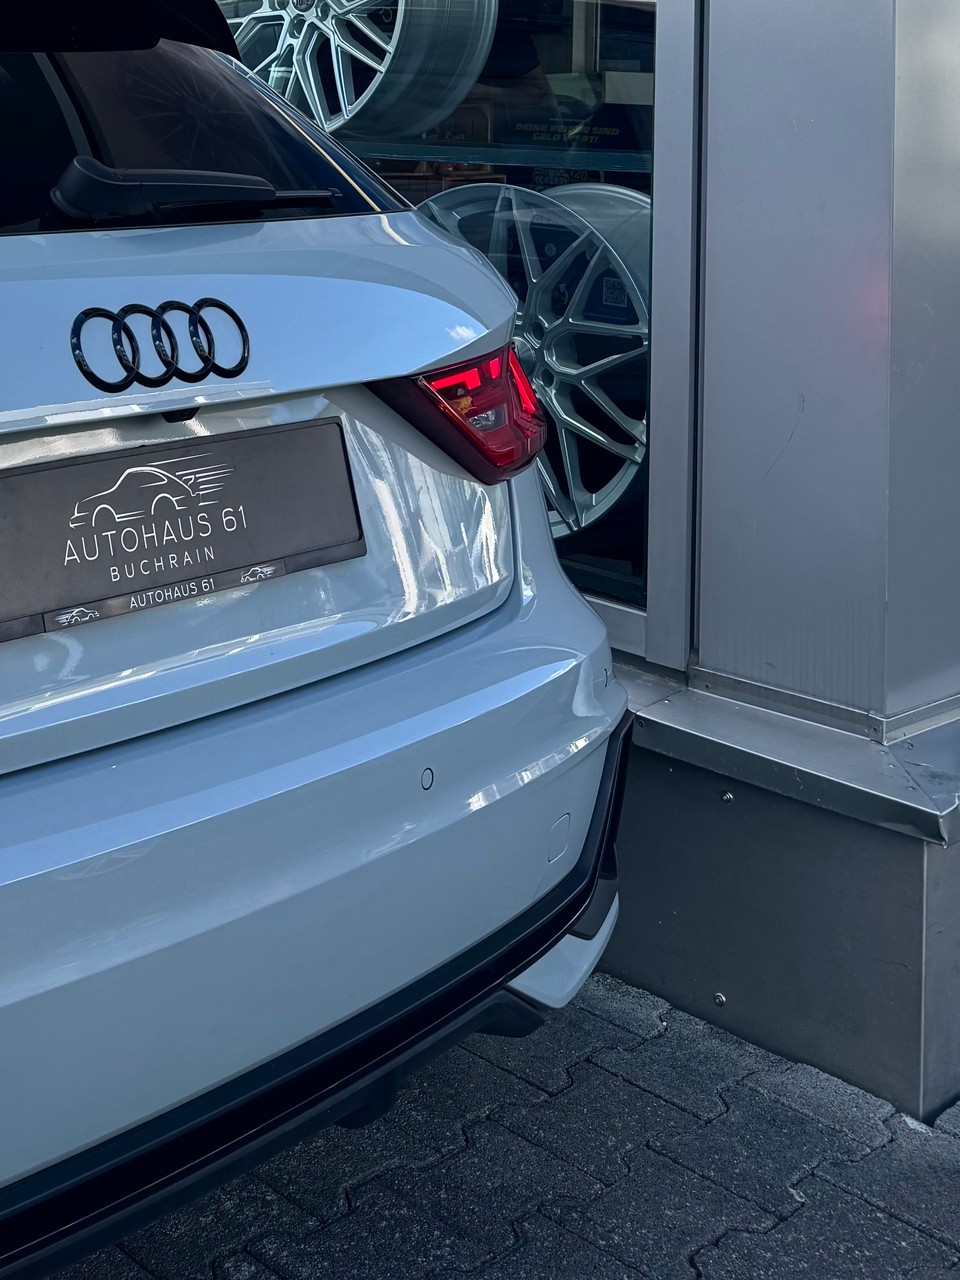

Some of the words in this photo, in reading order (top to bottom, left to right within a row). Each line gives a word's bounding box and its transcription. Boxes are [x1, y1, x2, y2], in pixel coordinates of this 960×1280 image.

[63, 513, 212, 566] AUTOHAUS
[222, 505, 247, 532] 61
[110, 545, 215, 582] BUCHRAIN
[129, 582, 198, 608] AUTOHAUS
[201, 578, 216, 592] 61
